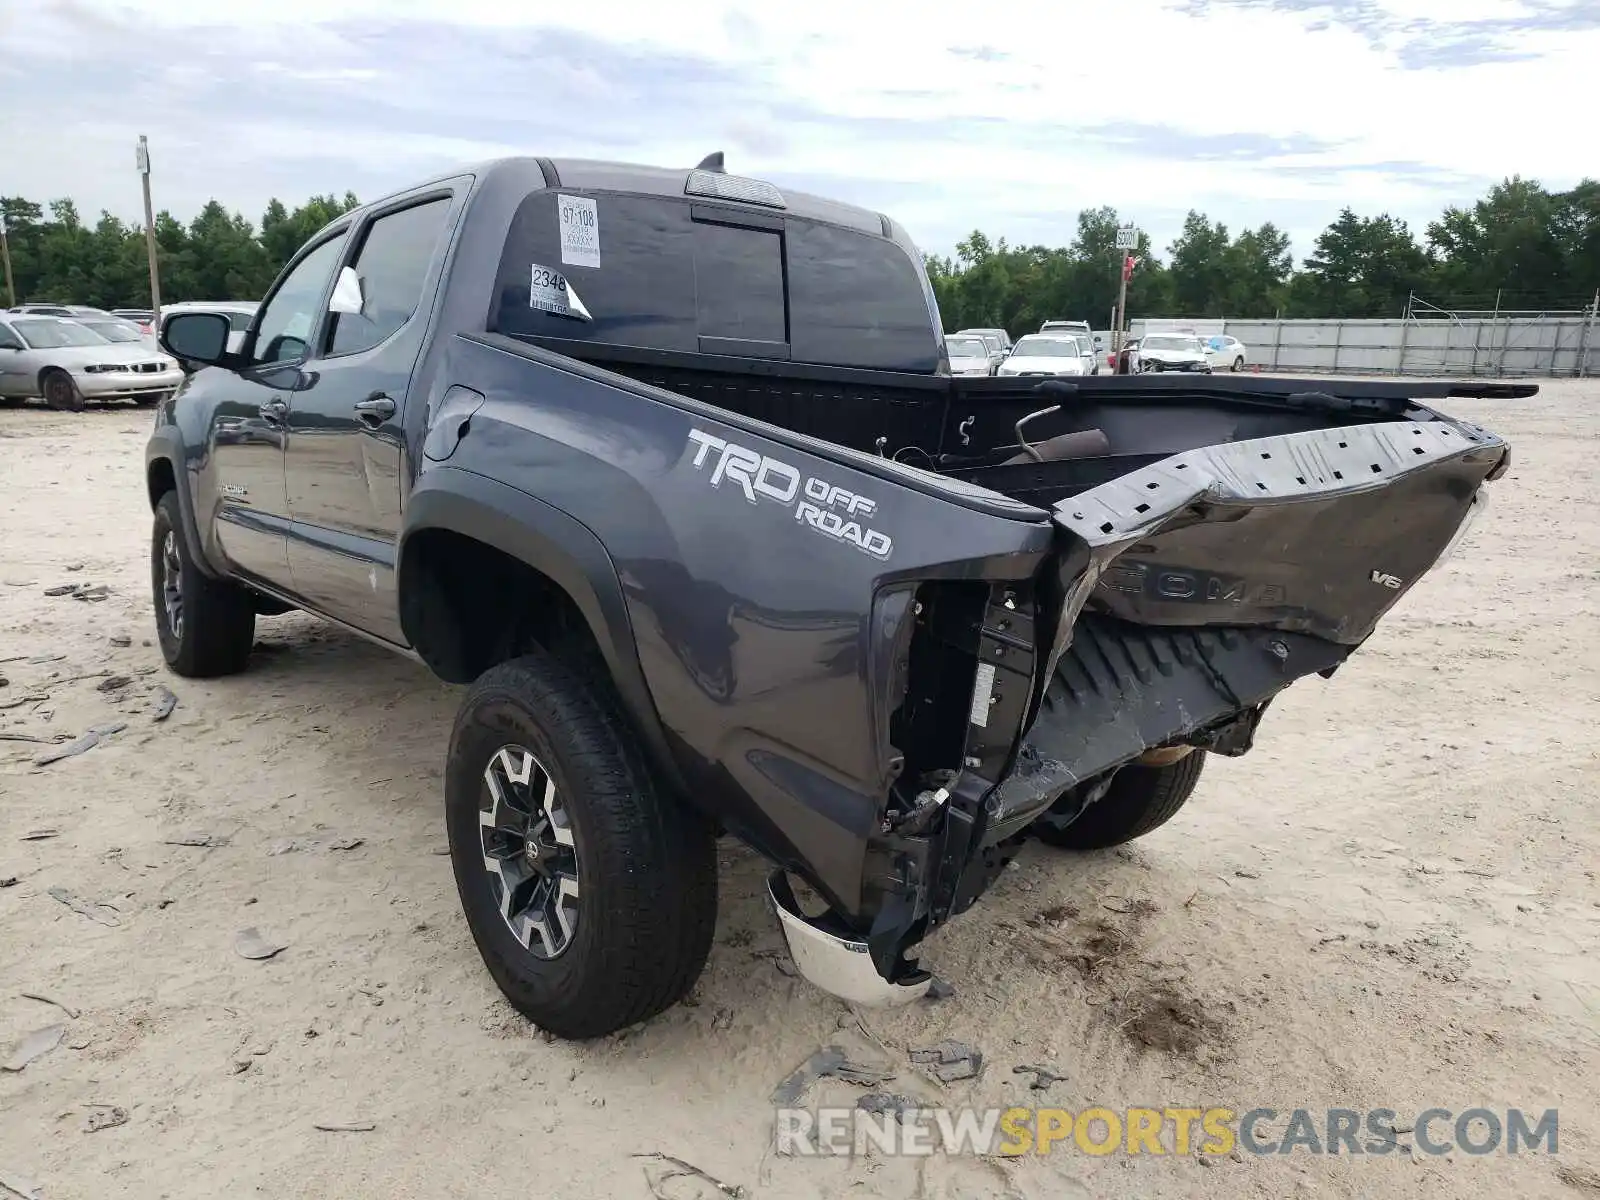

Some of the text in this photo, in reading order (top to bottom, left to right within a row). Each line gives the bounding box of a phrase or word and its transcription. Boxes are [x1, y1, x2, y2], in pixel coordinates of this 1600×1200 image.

[533, 269, 567, 291] 2348
[688, 428, 800, 505] TRD
[804, 476, 878, 519] OFF
[794, 500, 894, 561] ROAD
[1371, 570, 1403, 589] V6
